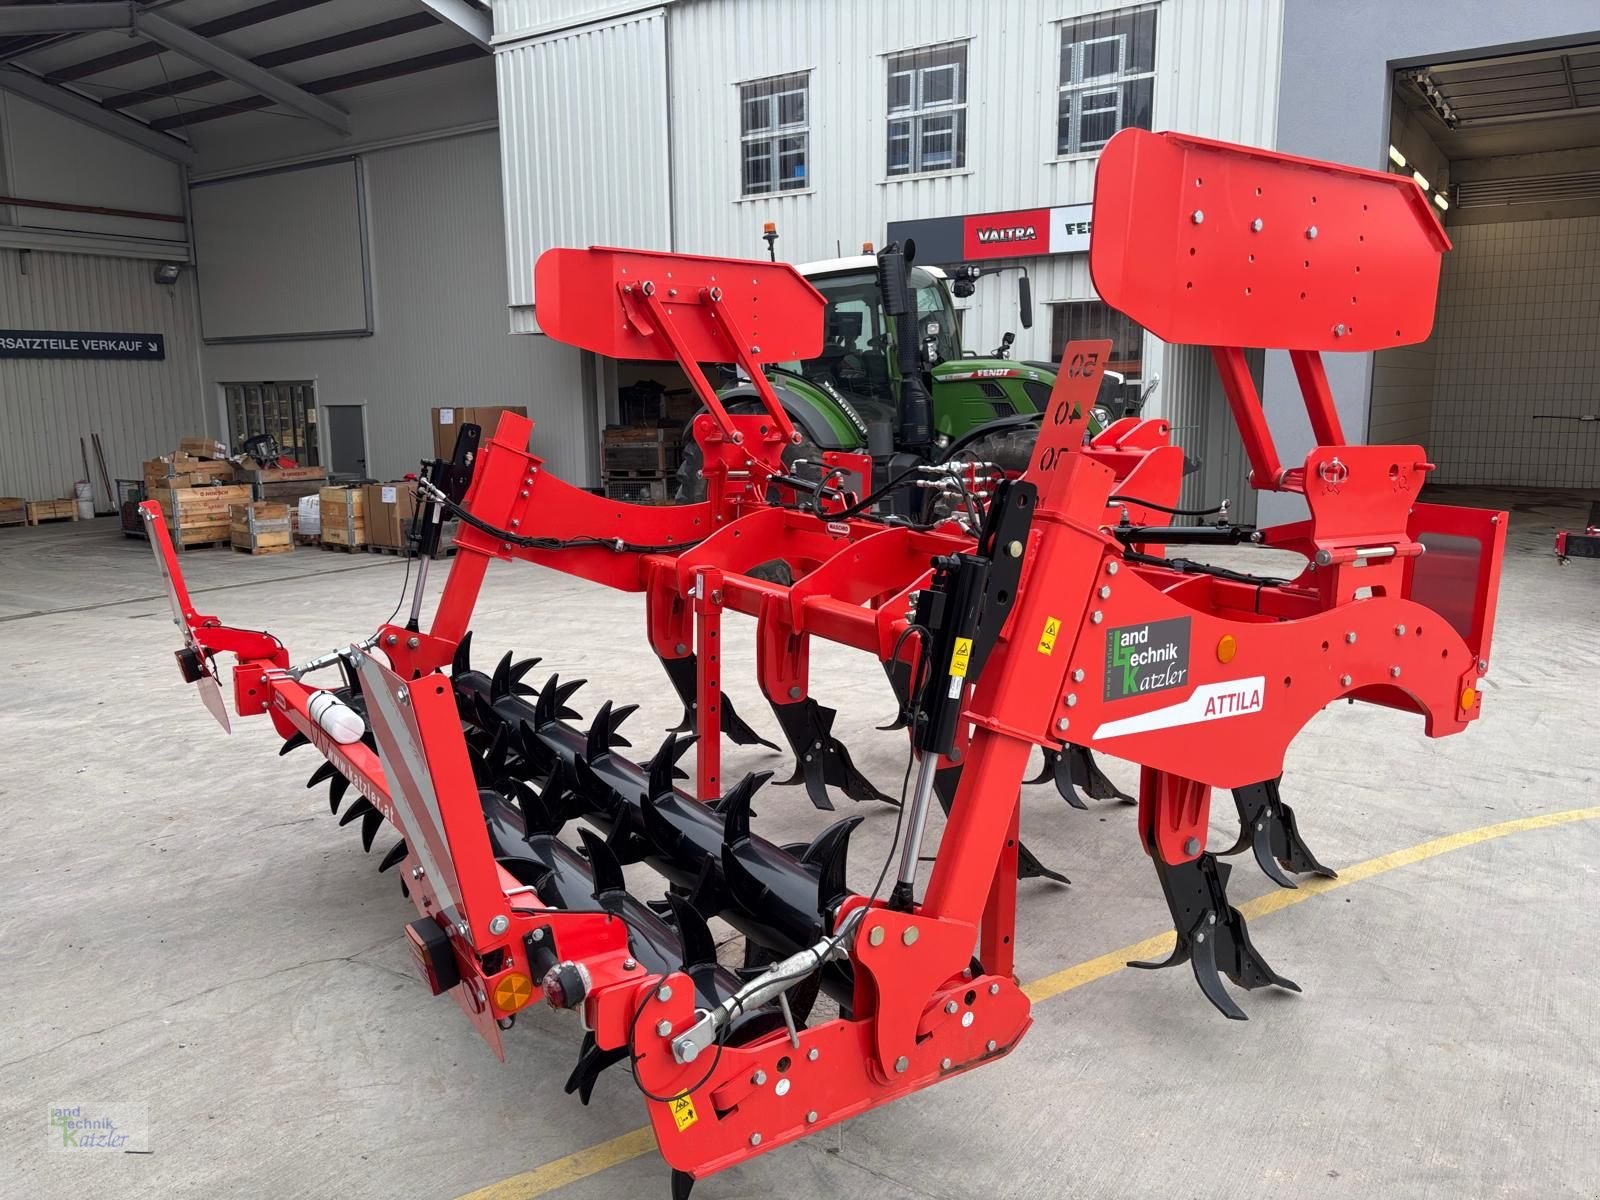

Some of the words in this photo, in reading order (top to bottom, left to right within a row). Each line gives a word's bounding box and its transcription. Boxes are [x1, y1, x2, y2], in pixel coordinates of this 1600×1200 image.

[976, 225, 1036, 244] VALTRA
[81, 340, 142, 351] VERKAUF
[976, 368, 1010, 377] FENDT
[1122, 661, 1188, 695] Katzler
[1204, 689, 1261, 717] ATTILA
